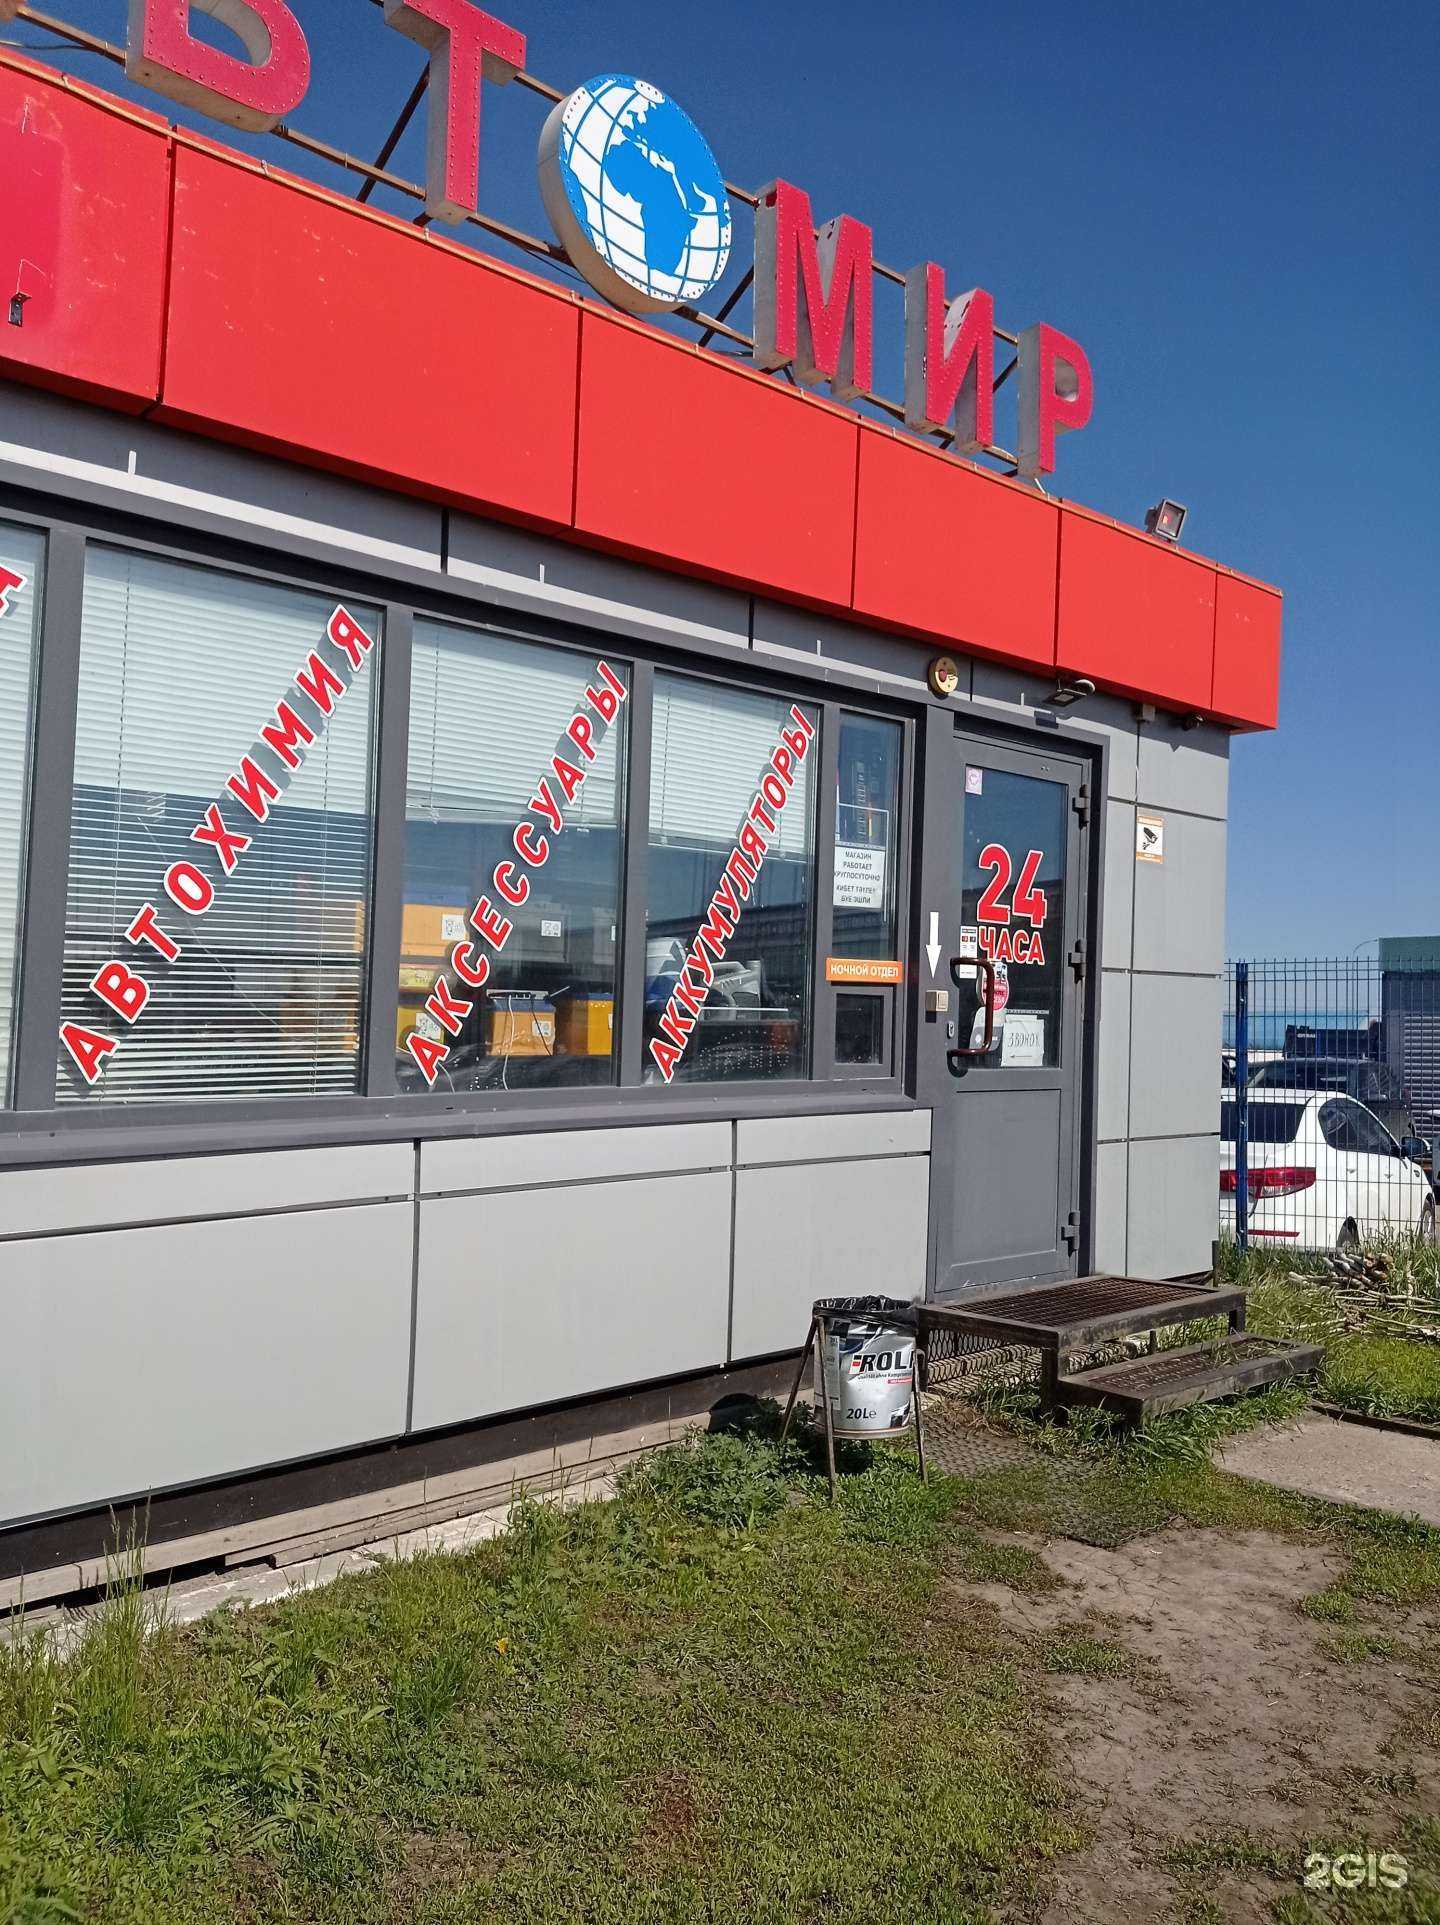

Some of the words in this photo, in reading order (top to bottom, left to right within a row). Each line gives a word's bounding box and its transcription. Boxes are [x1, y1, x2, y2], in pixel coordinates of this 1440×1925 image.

[756, 178, 1094, 478] МИР
[58, 602, 375, 1087] АВТОХИМИЯ
[405, 658, 630, 1087] АКСЕССУАРЫ
[842, 861, 873, 871] РАБОТАЕТ
[845, 850, 872, 861] МАГАЗИН
[648, 703, 817, 1085] АККУМУЛЯТОРЫ
[977, 843, 1048, 928] 24
[830, 962, 869, 977] НОЧНОЙ
[870, 965, 899, 979] ОТДЕЛ
[979, 925, 1046, 966] ЧАСА
[1007, 1032, 1040, 1048] ЗВОНОК
